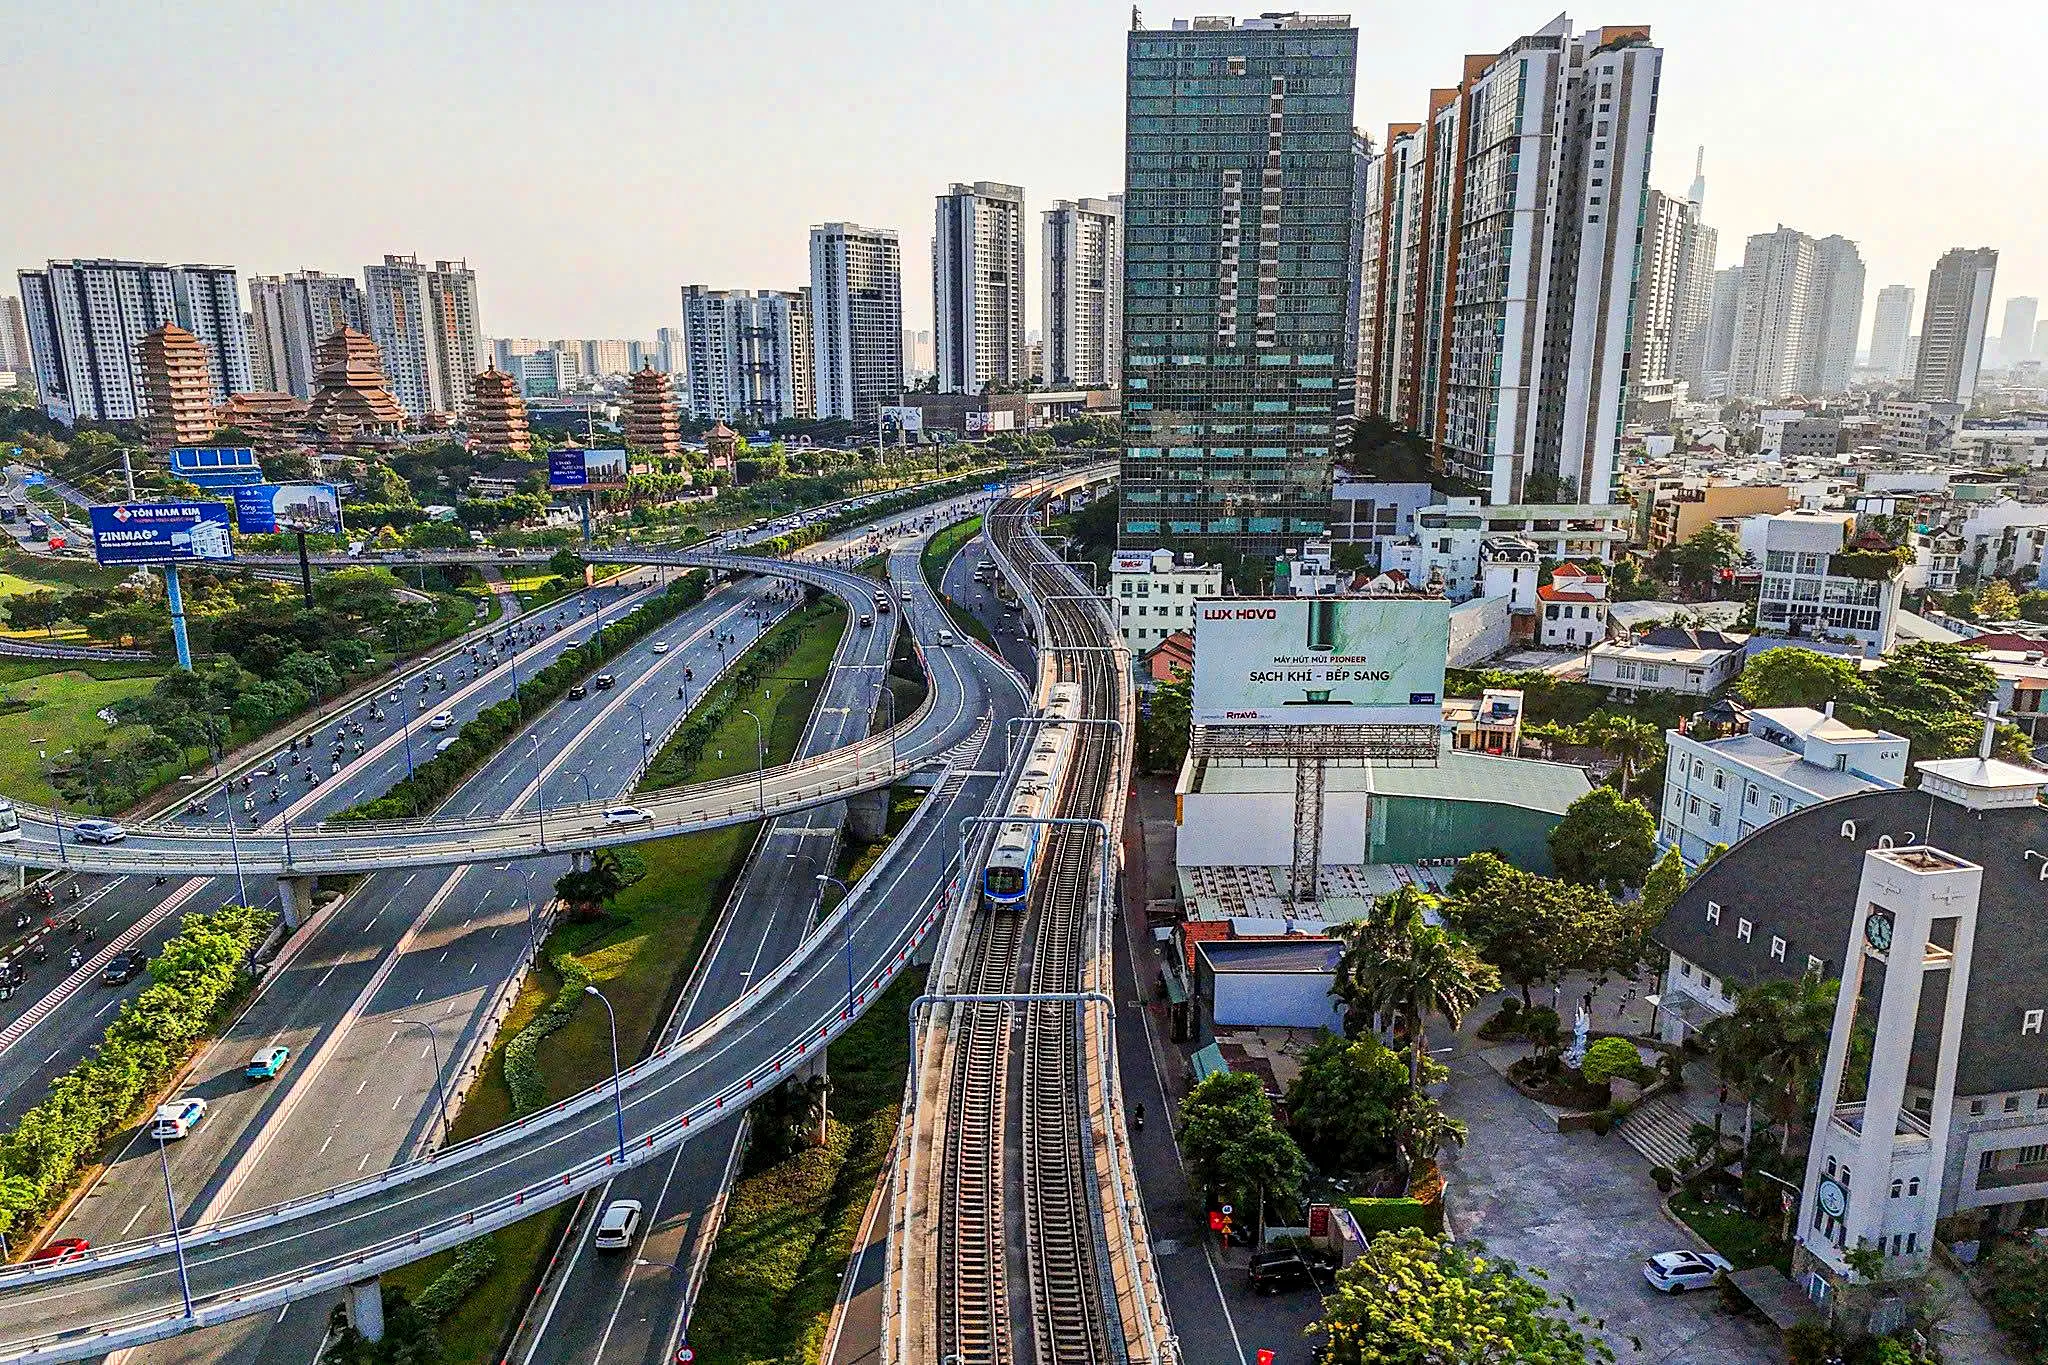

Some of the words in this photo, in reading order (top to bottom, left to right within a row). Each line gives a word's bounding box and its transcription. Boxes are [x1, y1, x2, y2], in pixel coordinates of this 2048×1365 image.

[131, 507, 154, 518] TÔN
[155, 508, 180, 517] NAM
[181, 507, 201, 516] KIM
[1204, 609, 1233, 620] LUX
[1235, 608, 1277, 620] HOVO
[1273, 654, 1291, 664] MÁY
[1292, 654, 1309, 664] HÚT
[1311, 654, 1328, 664] MÙI
[1249, 671, 1283, 684] SẠCH
[1287, 668, 1312, 682] KHÍ
[1325, 666, 1350, 682] BẾP
[1353, 670, 1390, 682] SANG
